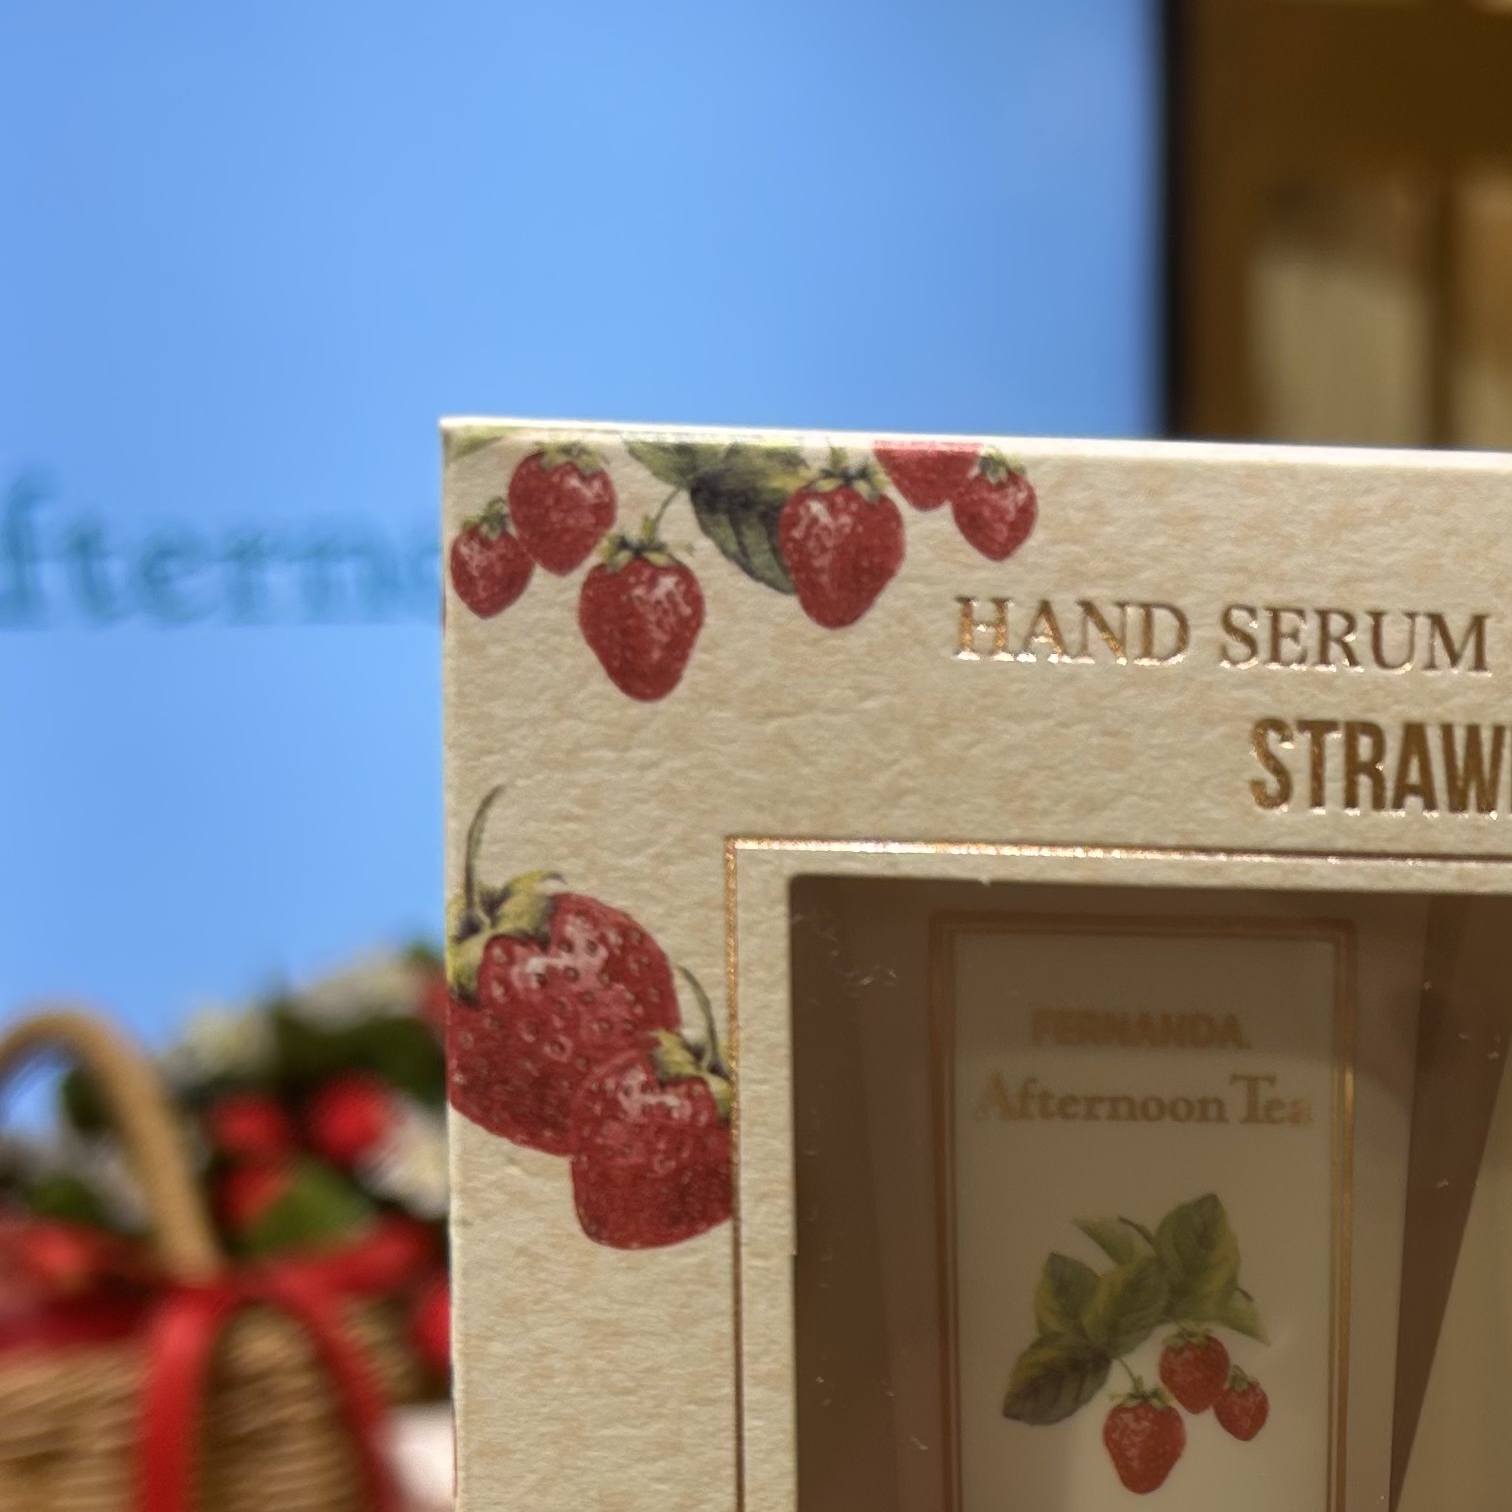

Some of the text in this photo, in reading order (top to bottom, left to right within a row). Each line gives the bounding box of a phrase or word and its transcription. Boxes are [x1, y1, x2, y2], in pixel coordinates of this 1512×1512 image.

[952, 596, 1191, 664] HAND
[1220, 604, 1491, 676] SERUM
[973, 1068, 1314, 1127] Afternoon Tea
